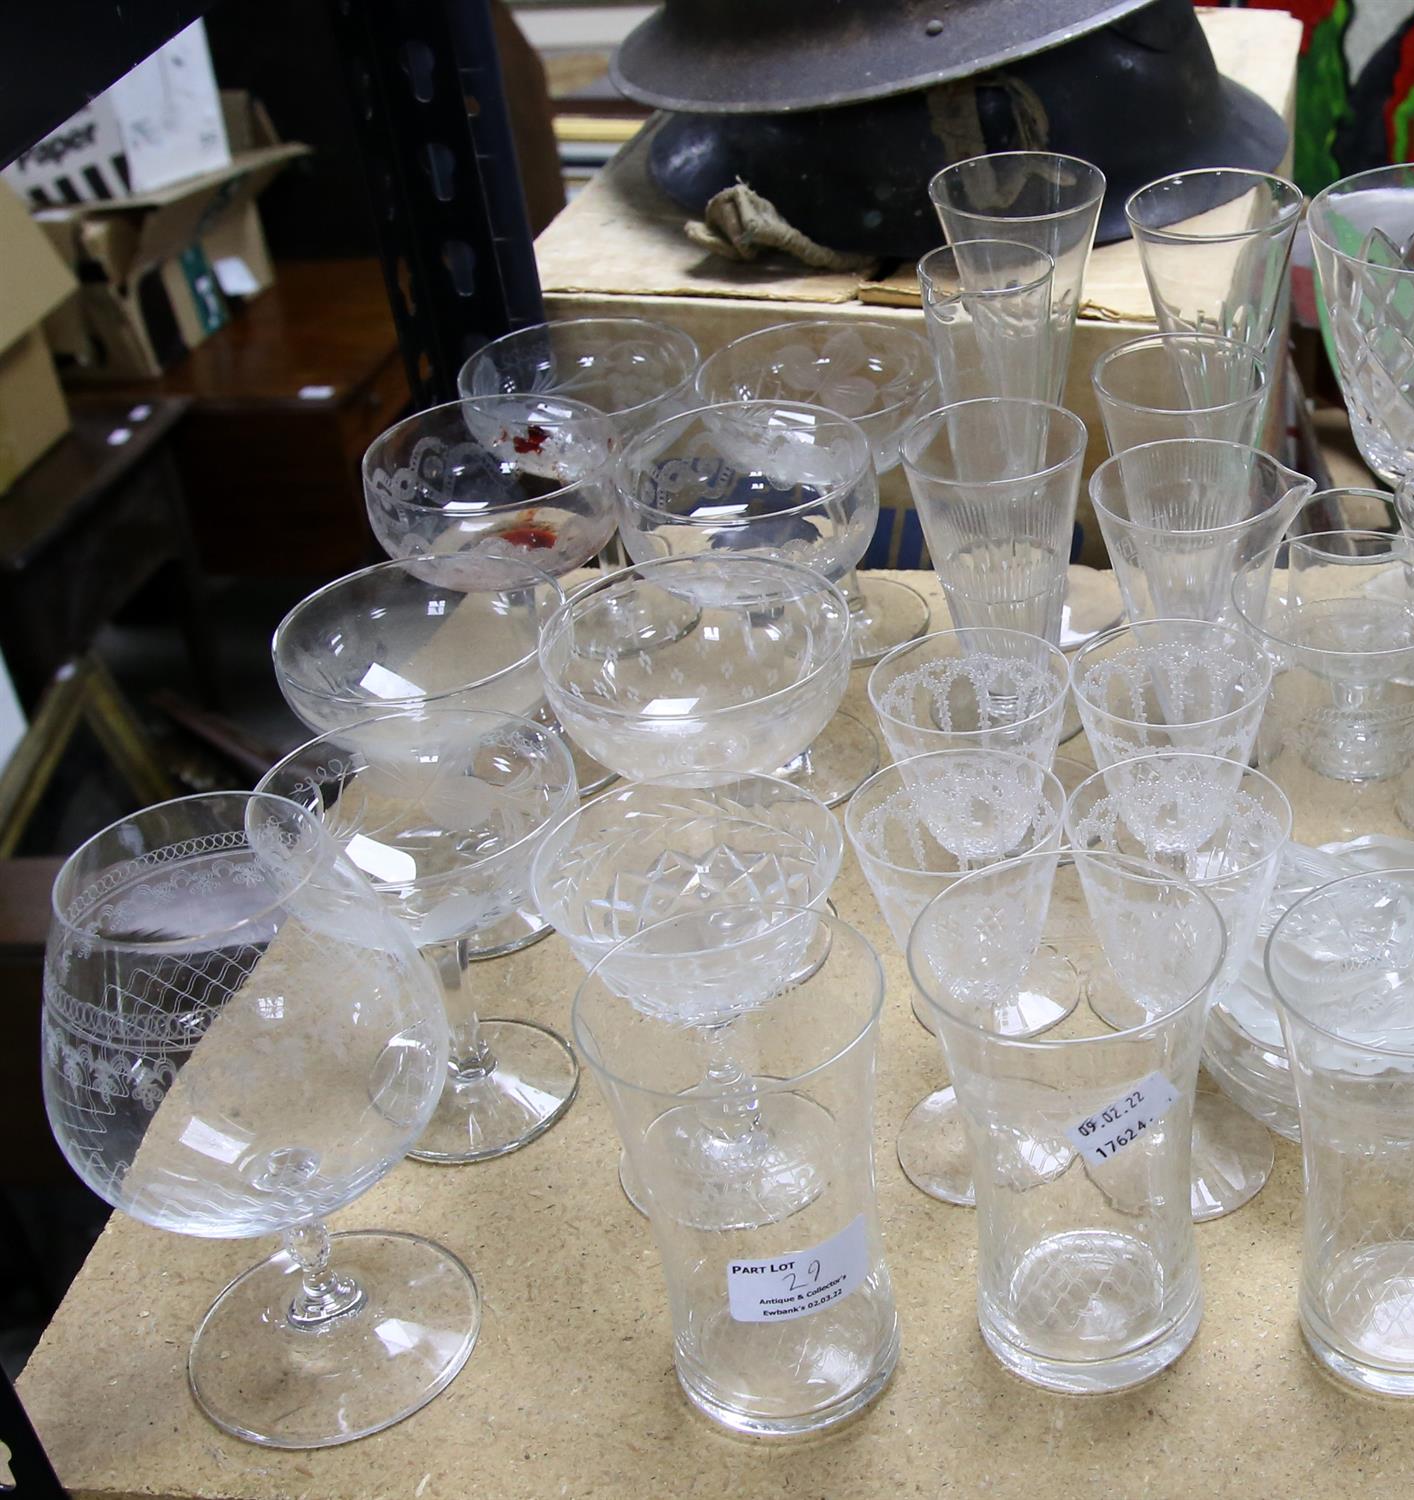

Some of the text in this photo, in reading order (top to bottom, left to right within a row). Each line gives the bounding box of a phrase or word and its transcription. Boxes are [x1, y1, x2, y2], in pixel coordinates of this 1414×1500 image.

[1078, 1091, 1145, 1137] 09.02.22
[732, 1261, 796, 1274] PART LOT
[782, 1259, 821, 1292] 29
[759, 1296, 795, 1306] Antique
[806, 1274, 847, 1298] Collector's
[763, 1305, 806, 1317] Ewbank's
